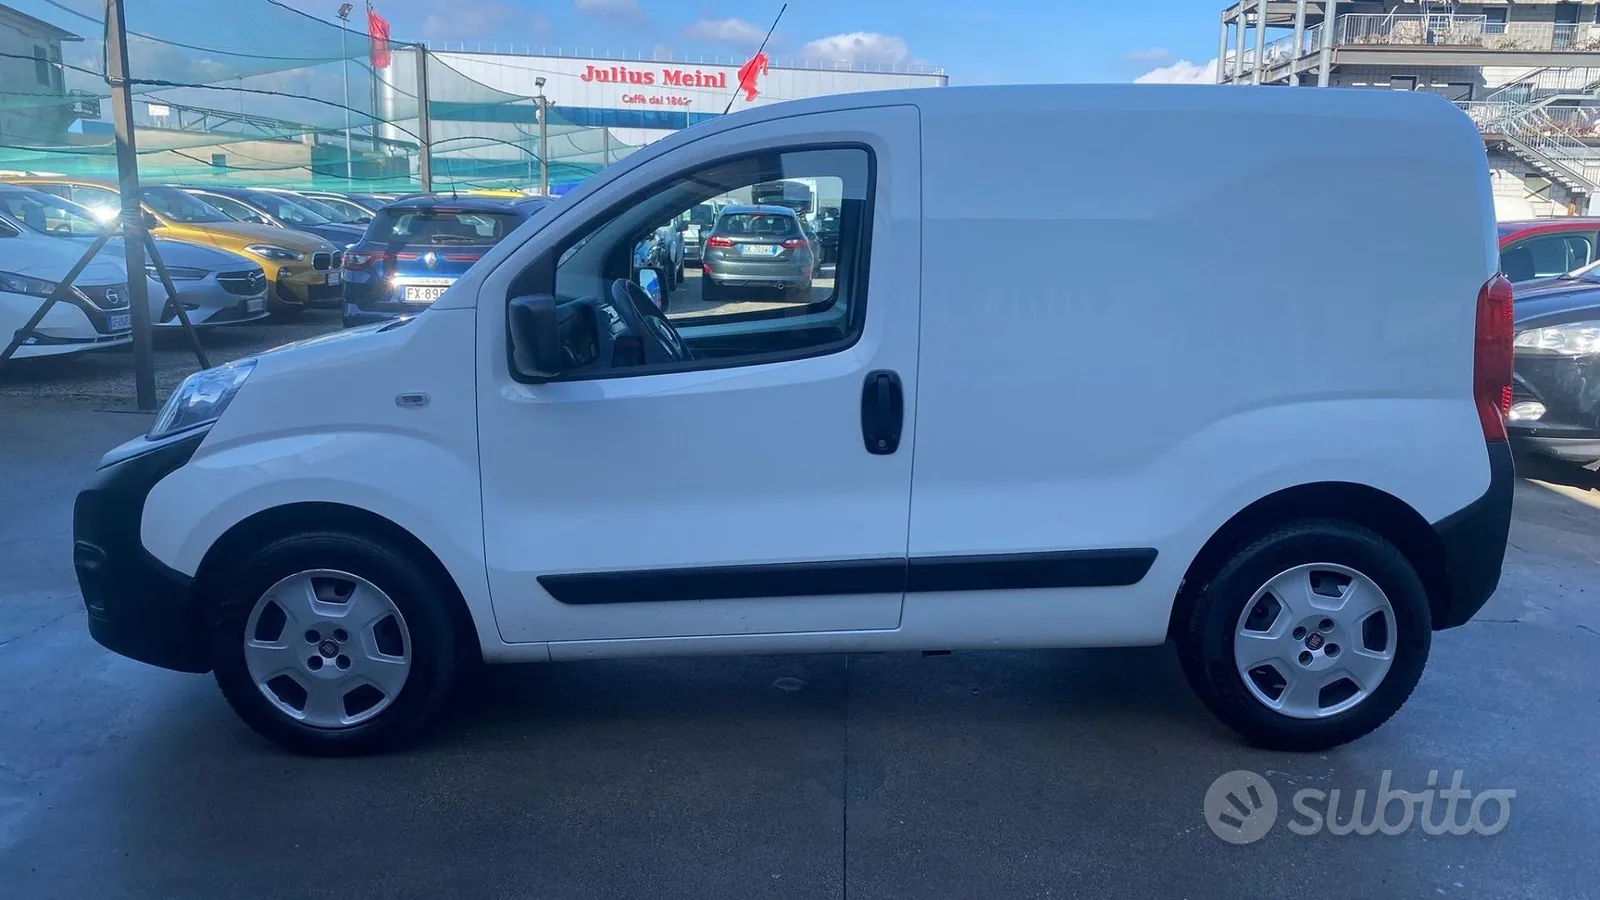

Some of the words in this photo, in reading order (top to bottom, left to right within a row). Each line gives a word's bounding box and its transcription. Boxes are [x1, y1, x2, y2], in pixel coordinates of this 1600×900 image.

[580, 65, 655, 85] Julius
[662, 69, 727, 88] Meinl
[621, 94, 647, 104] Caffè
[649, 95, 664, 105] dal
